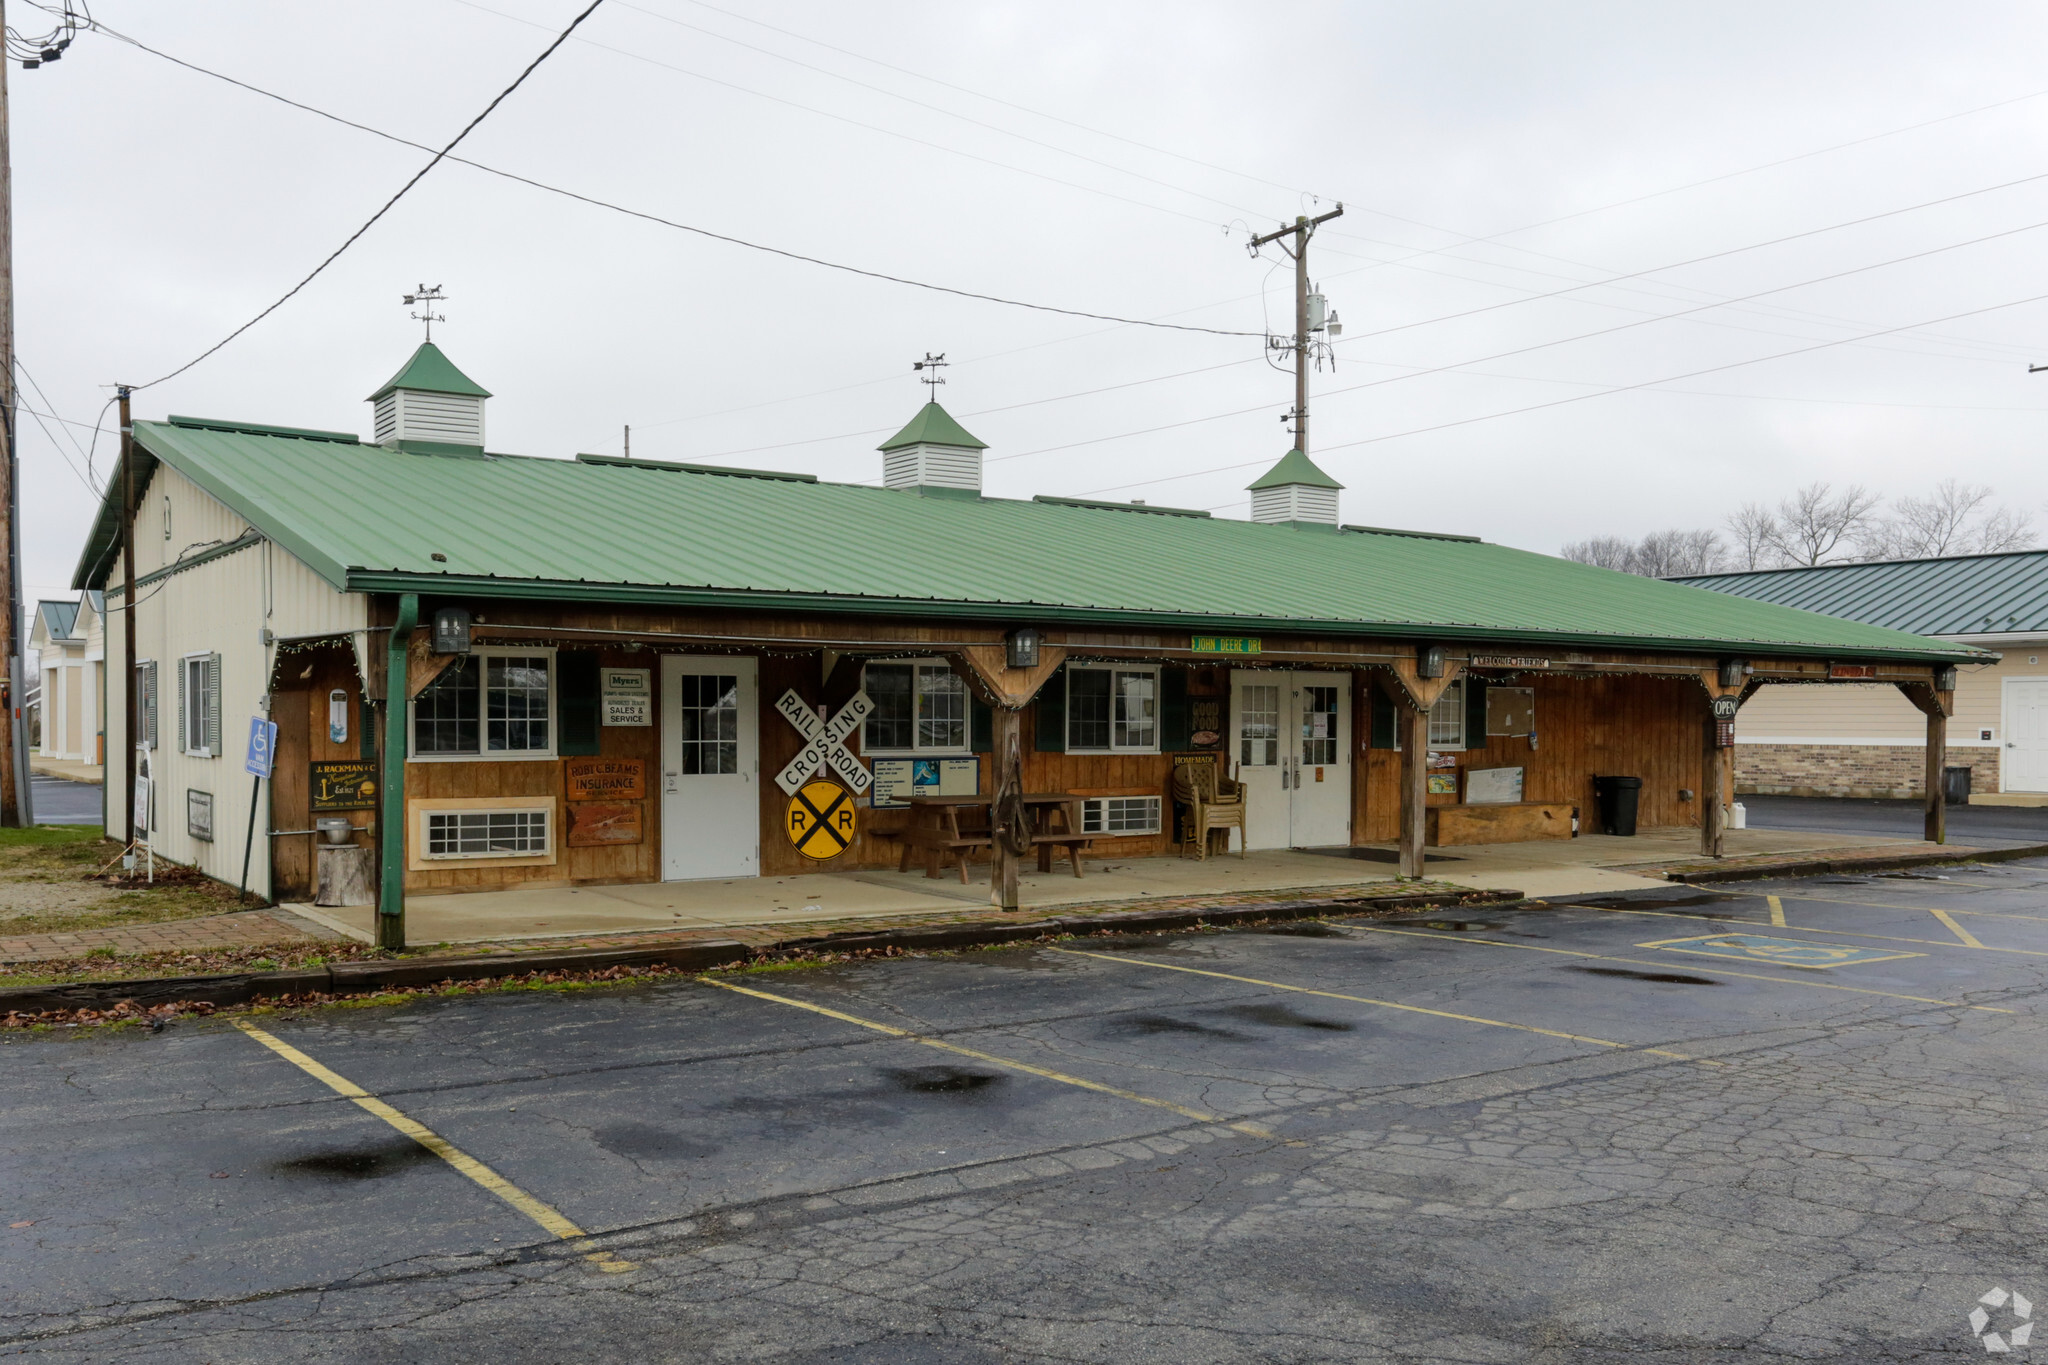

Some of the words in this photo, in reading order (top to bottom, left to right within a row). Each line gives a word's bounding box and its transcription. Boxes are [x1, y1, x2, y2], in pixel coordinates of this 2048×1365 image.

[438, 314, 446, 323] N
[1196, 638, 1215, 651] JOHN
[1220, 638, 1243, 652] DEERE
[1247, 639, 1258, 652] DR
[1478, 656, 1511, 666] WELCOME
[1517, 657, 1545, 667] FRIENDS
[612, 676, 639, 685] Myers
[1292, 690, 1299, 699] 19
[1192, 702, 1219, 716] GOOD
[1715, 701, 1736, 715] OPEN
[610, 715, 644, 723] SERVICE
[1192, 716, 1219, 731] FOOD
[780, 694, 815, 736] RAIL
[830, 747, 868, 788] ROAD
[785, 700, 866, 786] CROSSING
[1174, 755, 1215, 766] HOMEMADE
[324, 764, 364, 773] RACKMAN
[576, 778, 635, 789] INSURANCE
[792, 811, 805, 830] R
[838, 810, 853, 830] R
